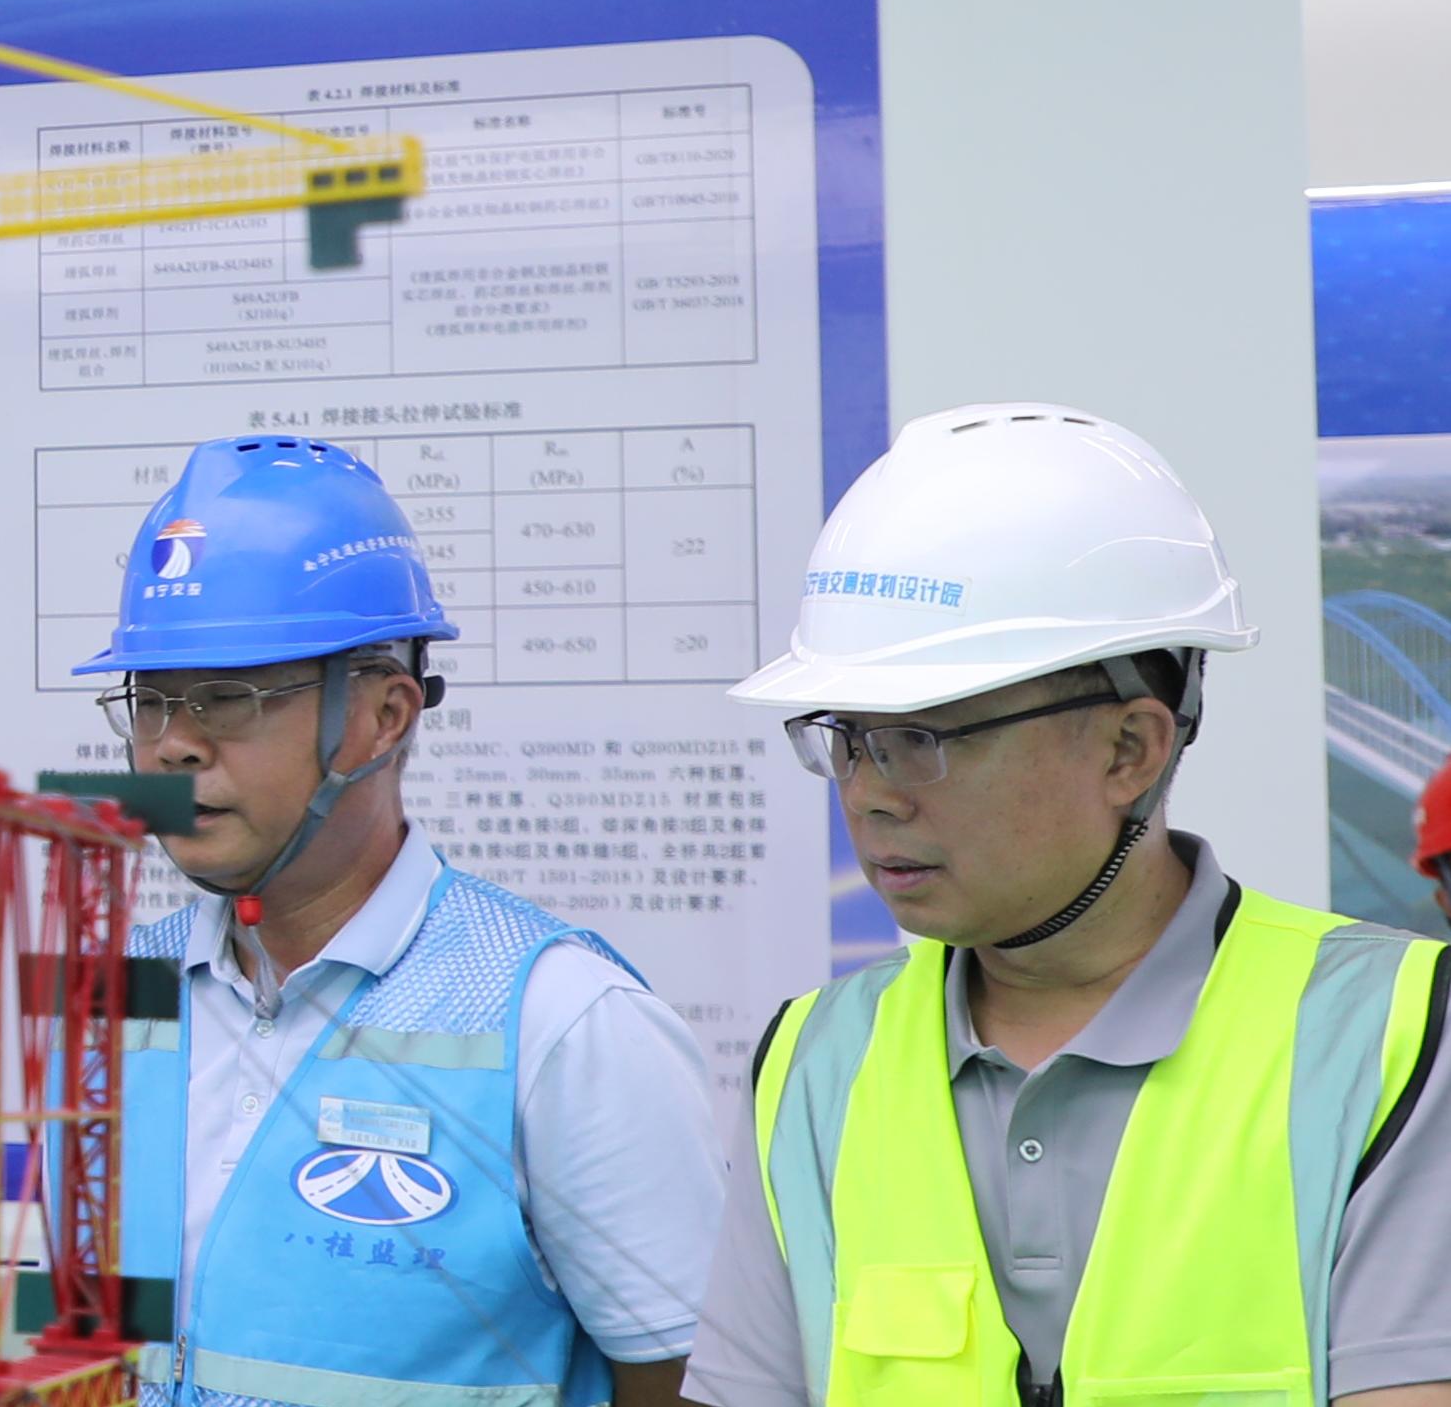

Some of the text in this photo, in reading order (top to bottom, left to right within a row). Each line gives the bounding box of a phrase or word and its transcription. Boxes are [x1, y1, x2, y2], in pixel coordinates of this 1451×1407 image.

[271, 410, 311, 427] 5.4.1
[321, 400, 523, 426] 焊接接头拉伸试验标准
[143, 582, 204, 599] 南宁交投
